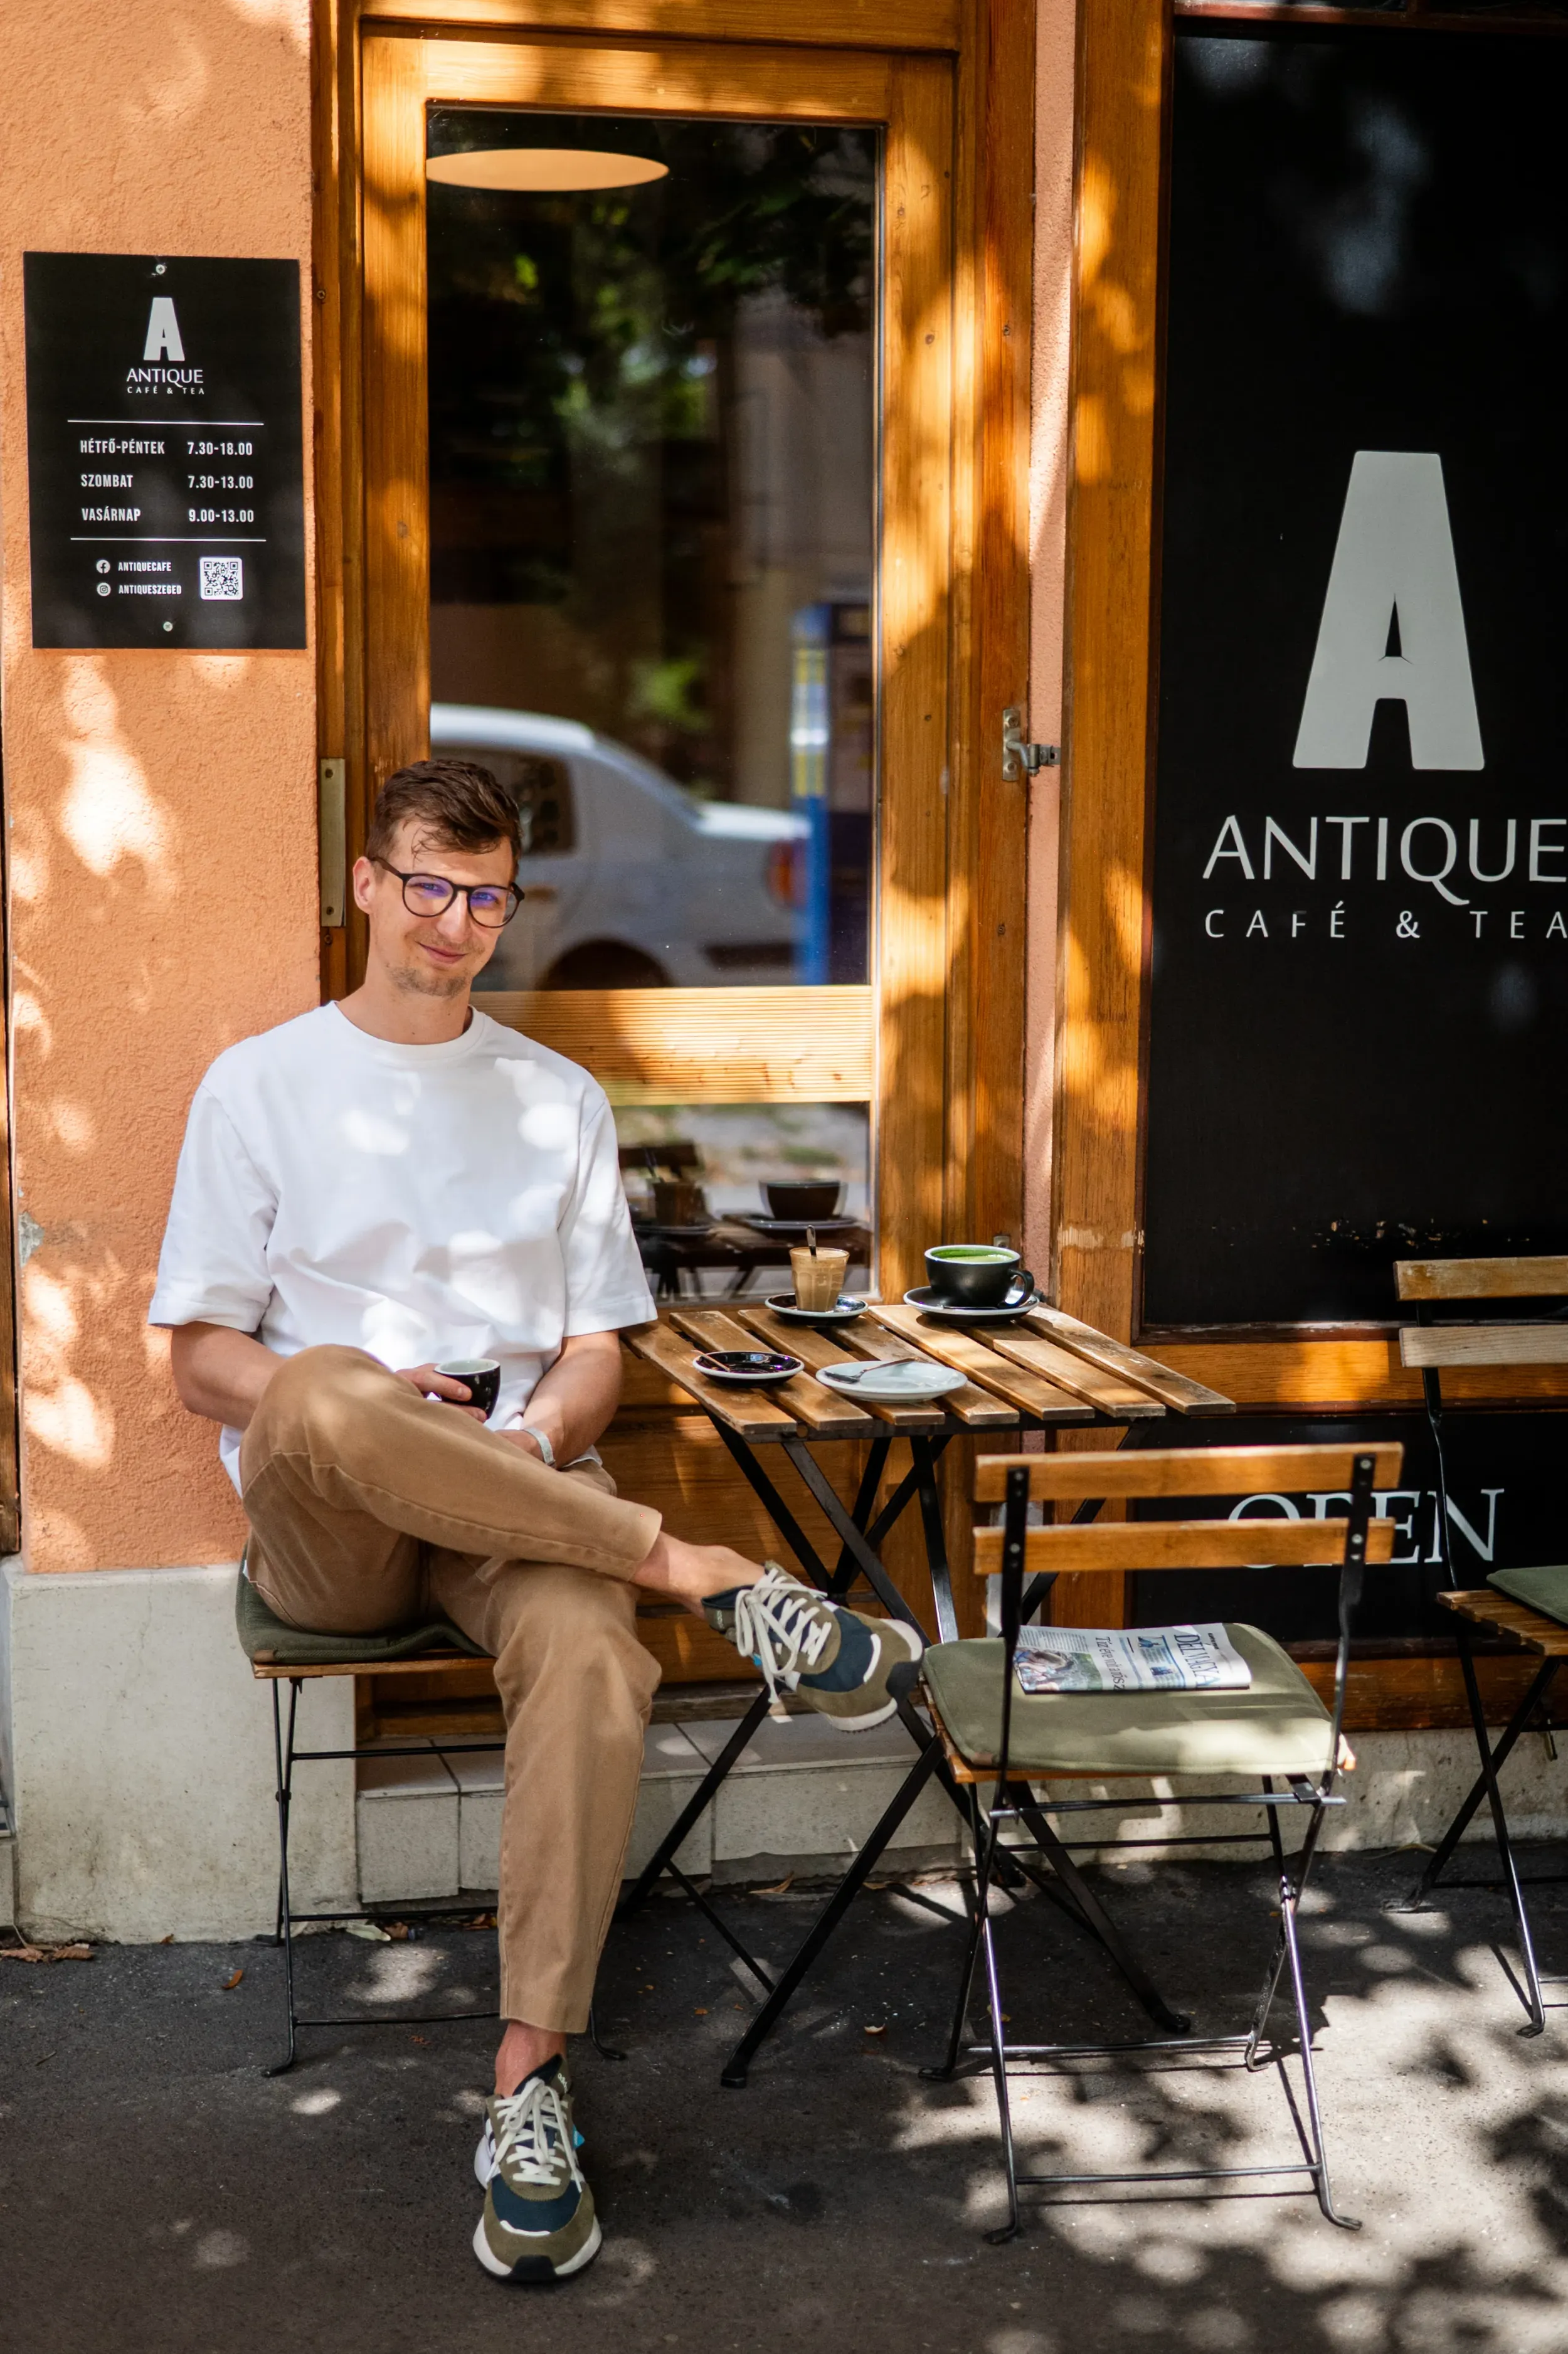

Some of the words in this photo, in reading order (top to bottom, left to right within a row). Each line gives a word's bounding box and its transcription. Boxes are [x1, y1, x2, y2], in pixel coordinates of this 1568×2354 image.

[143, 297, 185, 362] A
[127, 368, 204, 388] ANTIQUE
[127, 386, 158, 394] CAFÉ
[80, 438, 166, 454] HÉTFŐ-PÉNTEK
[188, 442, 253, 456] 7.30-18.00
[80, 474, 134, 487] SZOMBAT
[188, 475, 254, 489] 7.30-13.00
[82, 506, 141, 521] VASÁRNAP
[189, 509, 255, 522] 9.00-13.00
[118, 562, 172, 572] ANTIQUECAFE
[119, 585, 182, 595] ANTIQUESZEGED
[1293, 450, 1485, 770] A
[1202, 815, 1567, 906] ANTIQUE
[1205, 901, 1345, 939] CAFÉ
[1396, 910, 1421, 939] &
[1470, 911, 1567, 939] TEA
